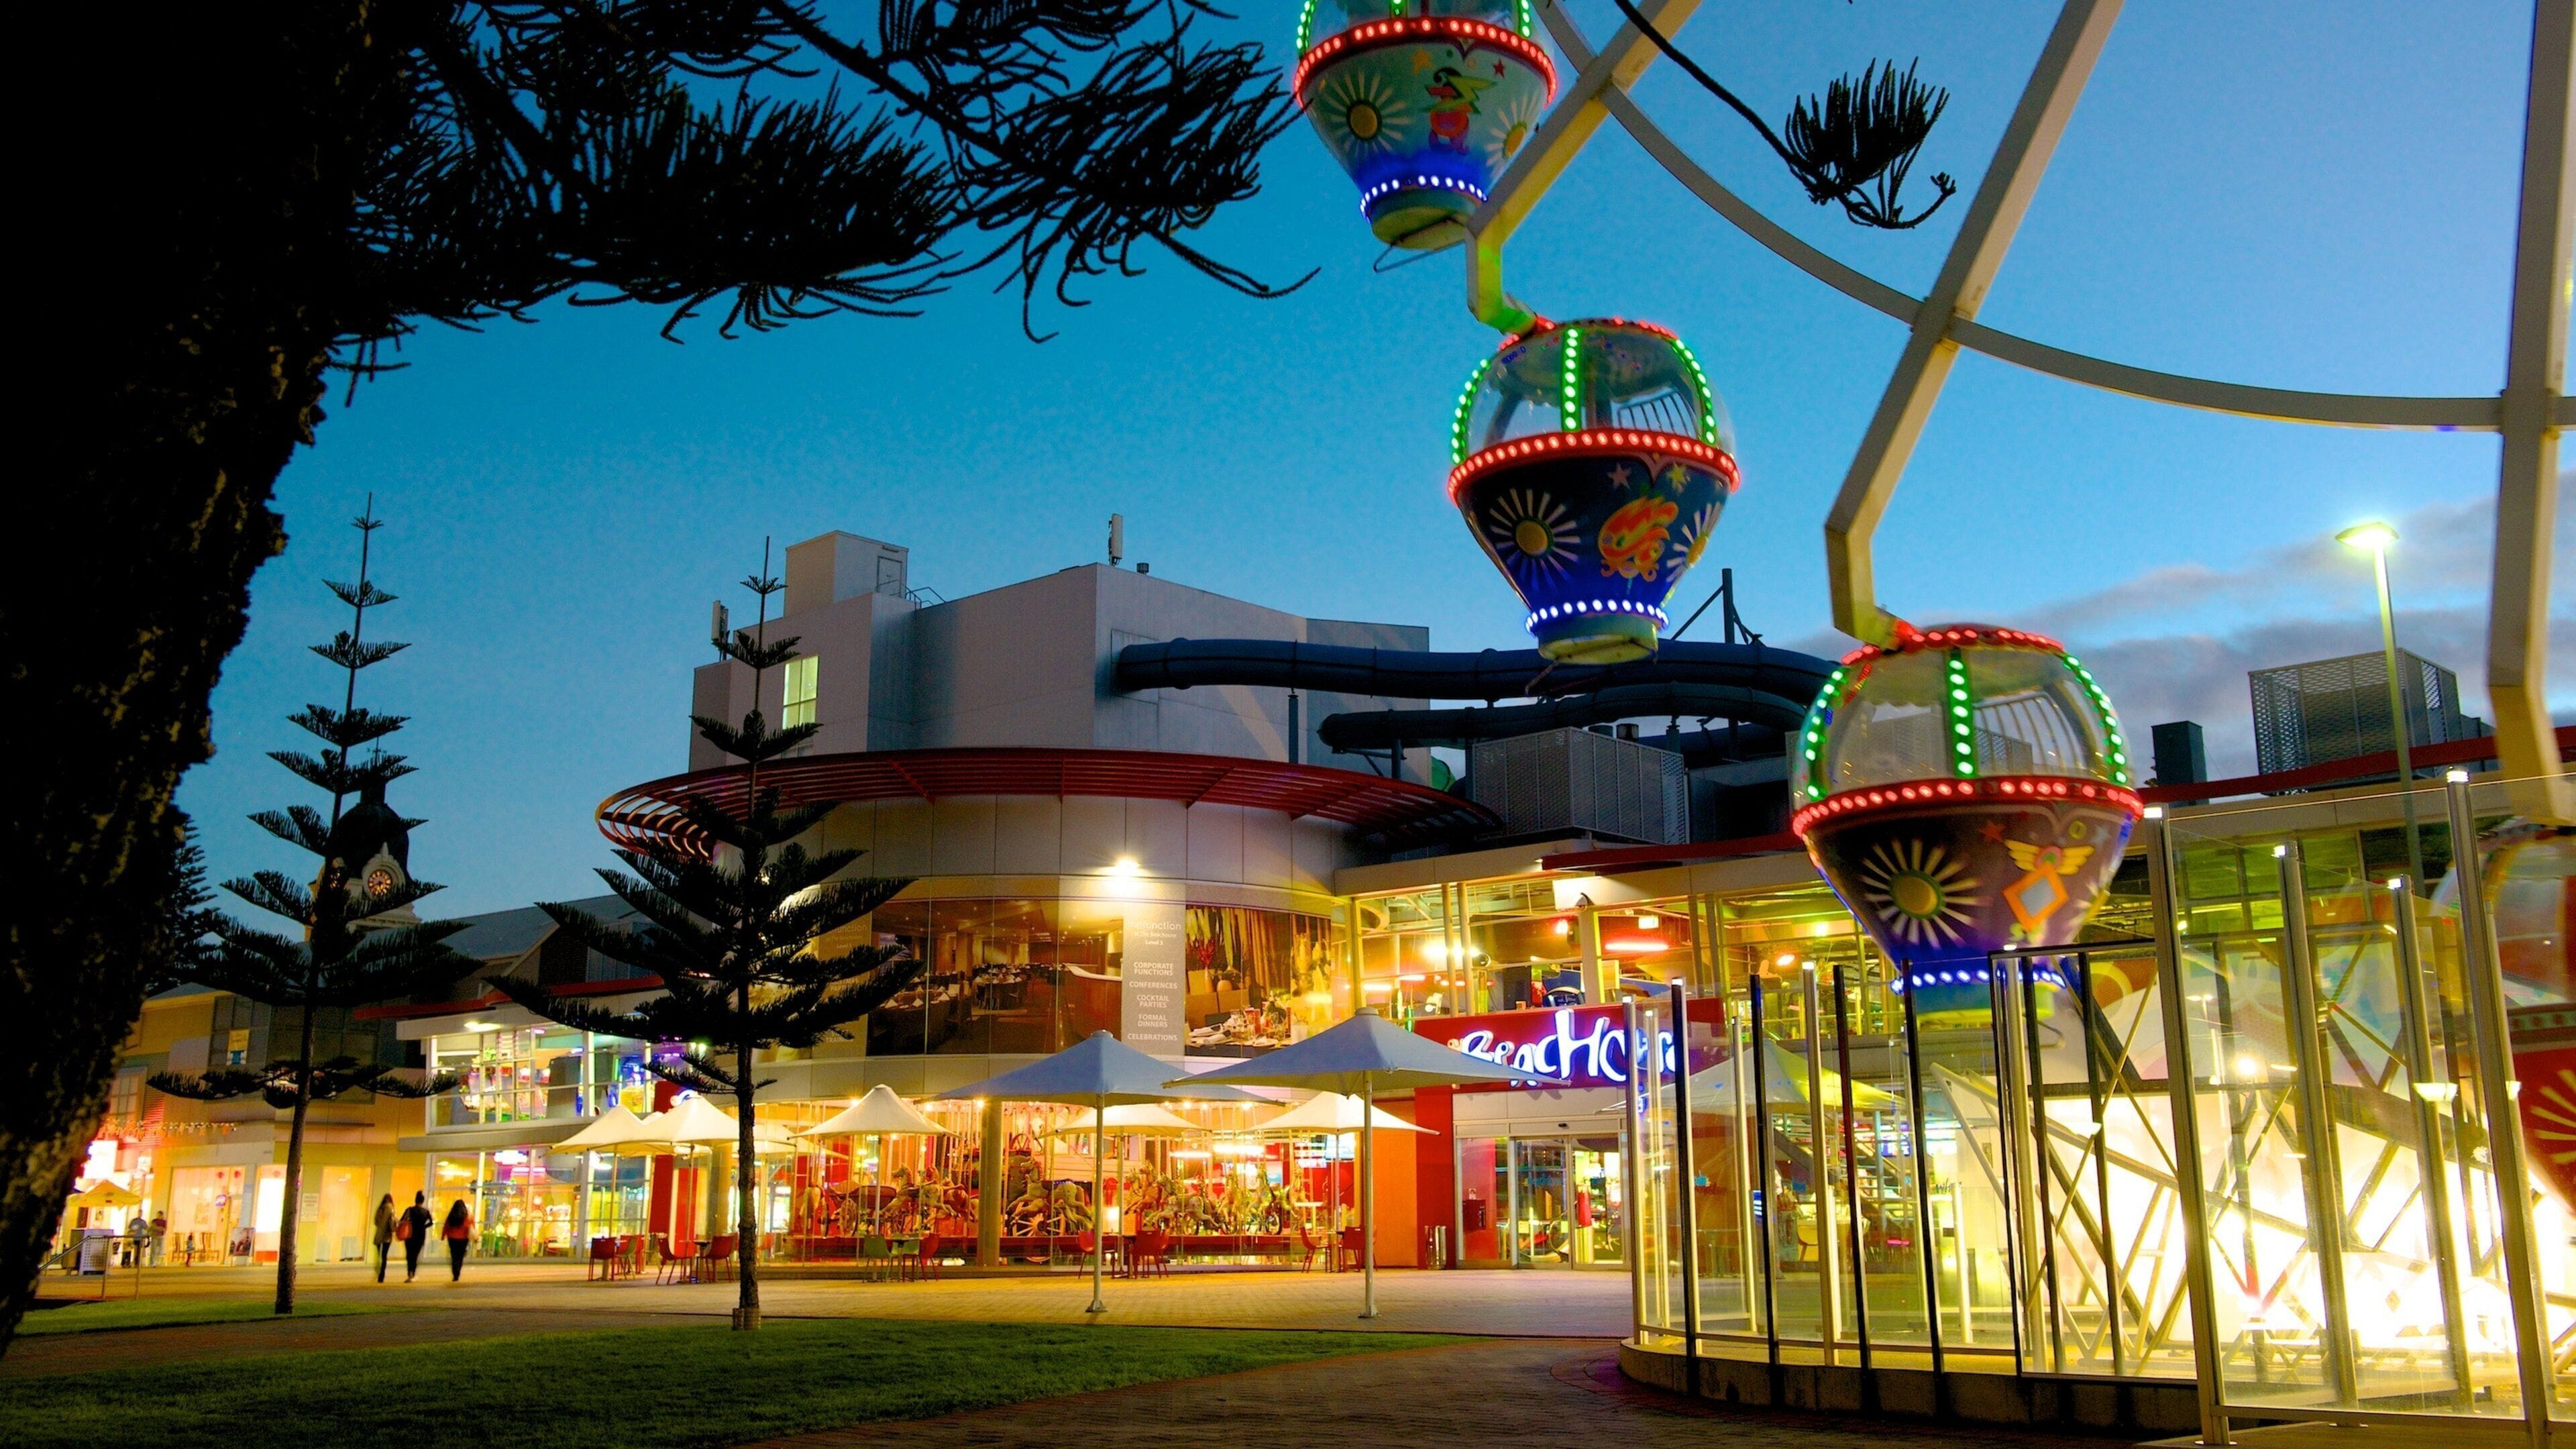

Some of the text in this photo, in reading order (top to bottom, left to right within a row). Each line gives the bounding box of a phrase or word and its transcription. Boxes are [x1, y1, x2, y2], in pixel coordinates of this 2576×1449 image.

[1134, 961, 1173, 969] CORPORATE
[1134, 968, 1173, 976] FUNCTIONS
[1129, 981, 1178, 989] CONFERENCES
[1136, 994, 1170, 1002] COCKTAIL
[1127, 1033, 1178, 1042] CELEBRATIONS
